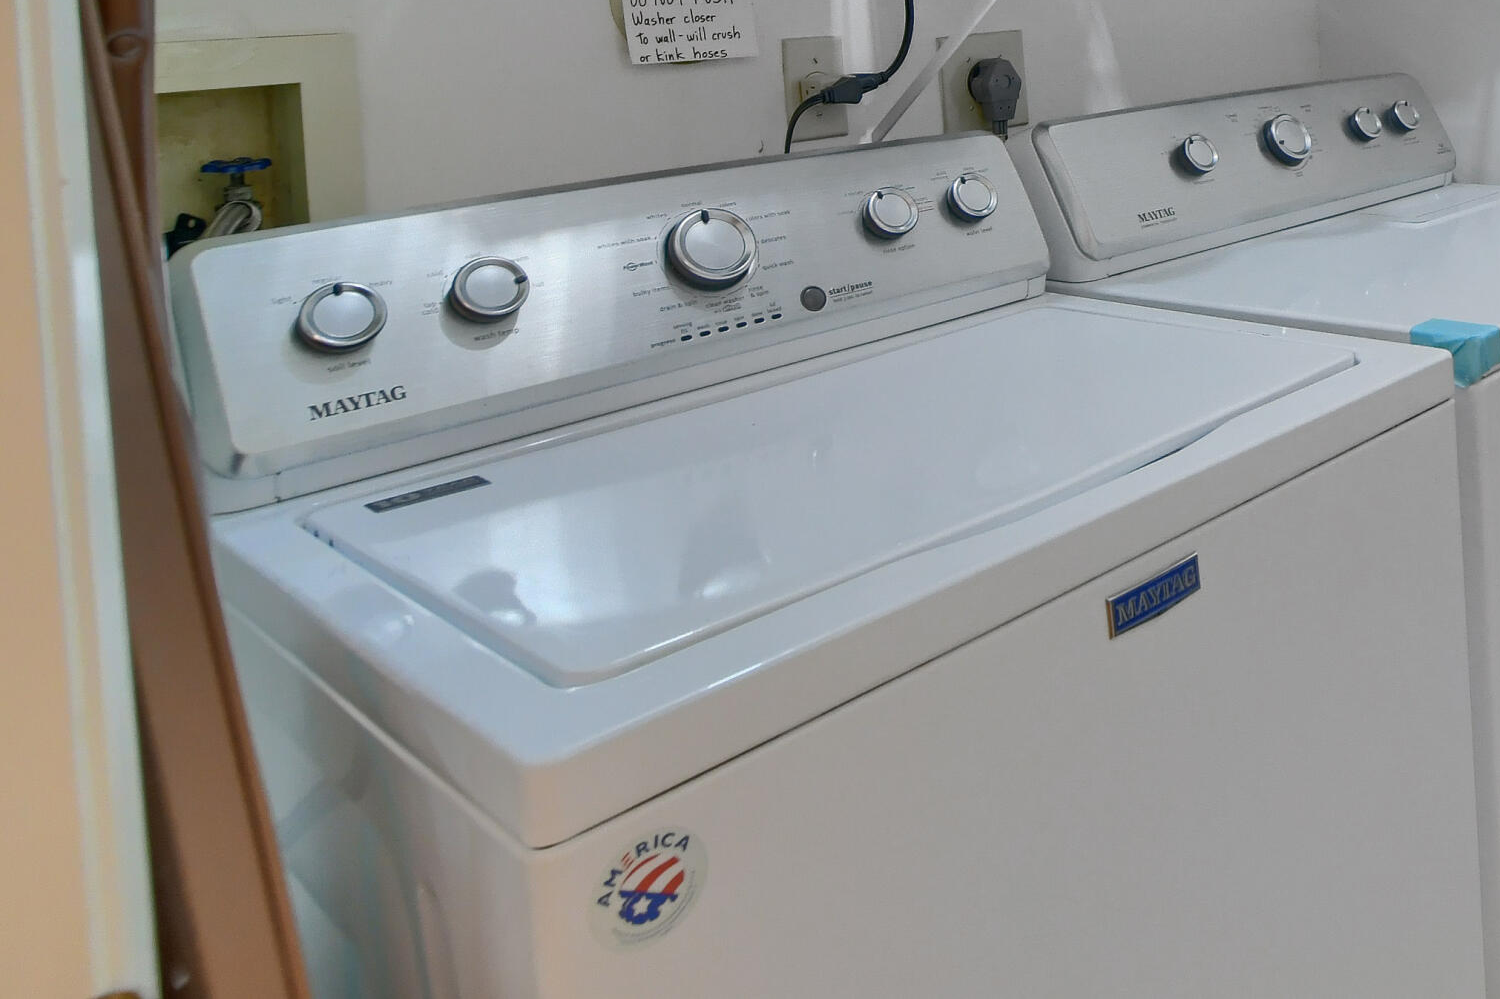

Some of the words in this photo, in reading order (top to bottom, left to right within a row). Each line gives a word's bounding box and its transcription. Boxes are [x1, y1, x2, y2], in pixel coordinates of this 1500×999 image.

[631, 10, 676, 26] Washer
[683, 8, 716, 23] closer
[711, 25, 741, 41] crush
[640, 53, 651, 63] or
[655, 46, 685, 62] kink
[692, 46, 728, 59] hoses
[1137, 206, 1176, 223] MAYTAG
[828, 280, 873, 296] start/pause
[307, 385, 408, 421] MAYTAG
[1116, 565, 1197, 627] MAYTAG
